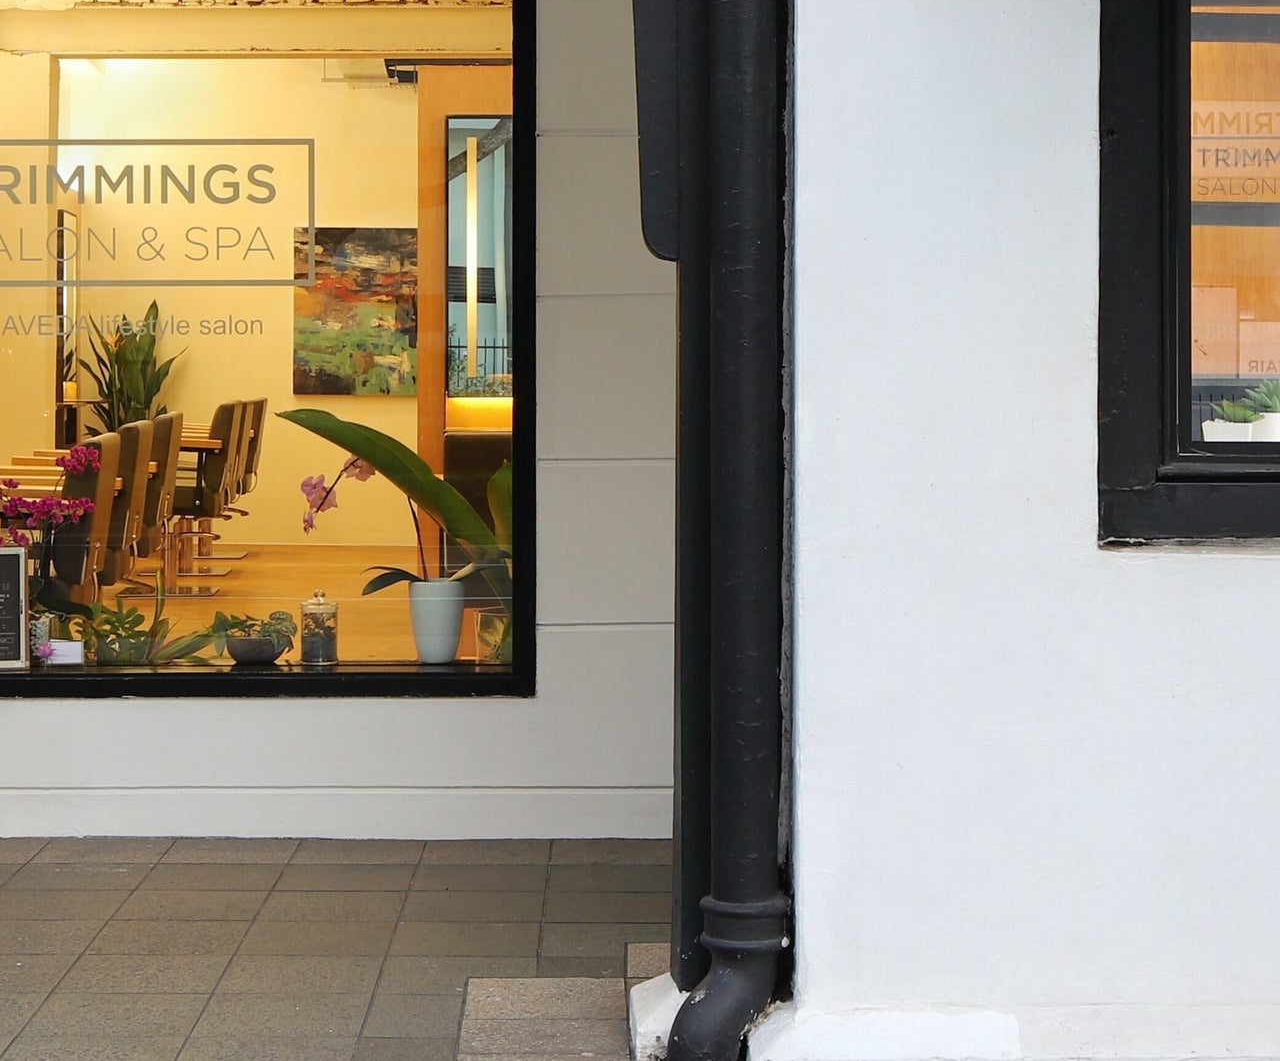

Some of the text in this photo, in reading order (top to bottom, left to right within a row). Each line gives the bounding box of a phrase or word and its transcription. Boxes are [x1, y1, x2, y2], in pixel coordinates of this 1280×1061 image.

[1197, 177, 1277, 196] SALON
[136, 226, 166, 262] &
[184, 226, 276, 261] SPA
[2, 315, 92, 336] AVEDA
[99, 315, 190, 341] lifestyle
[199, 315, 264, 336] salon
